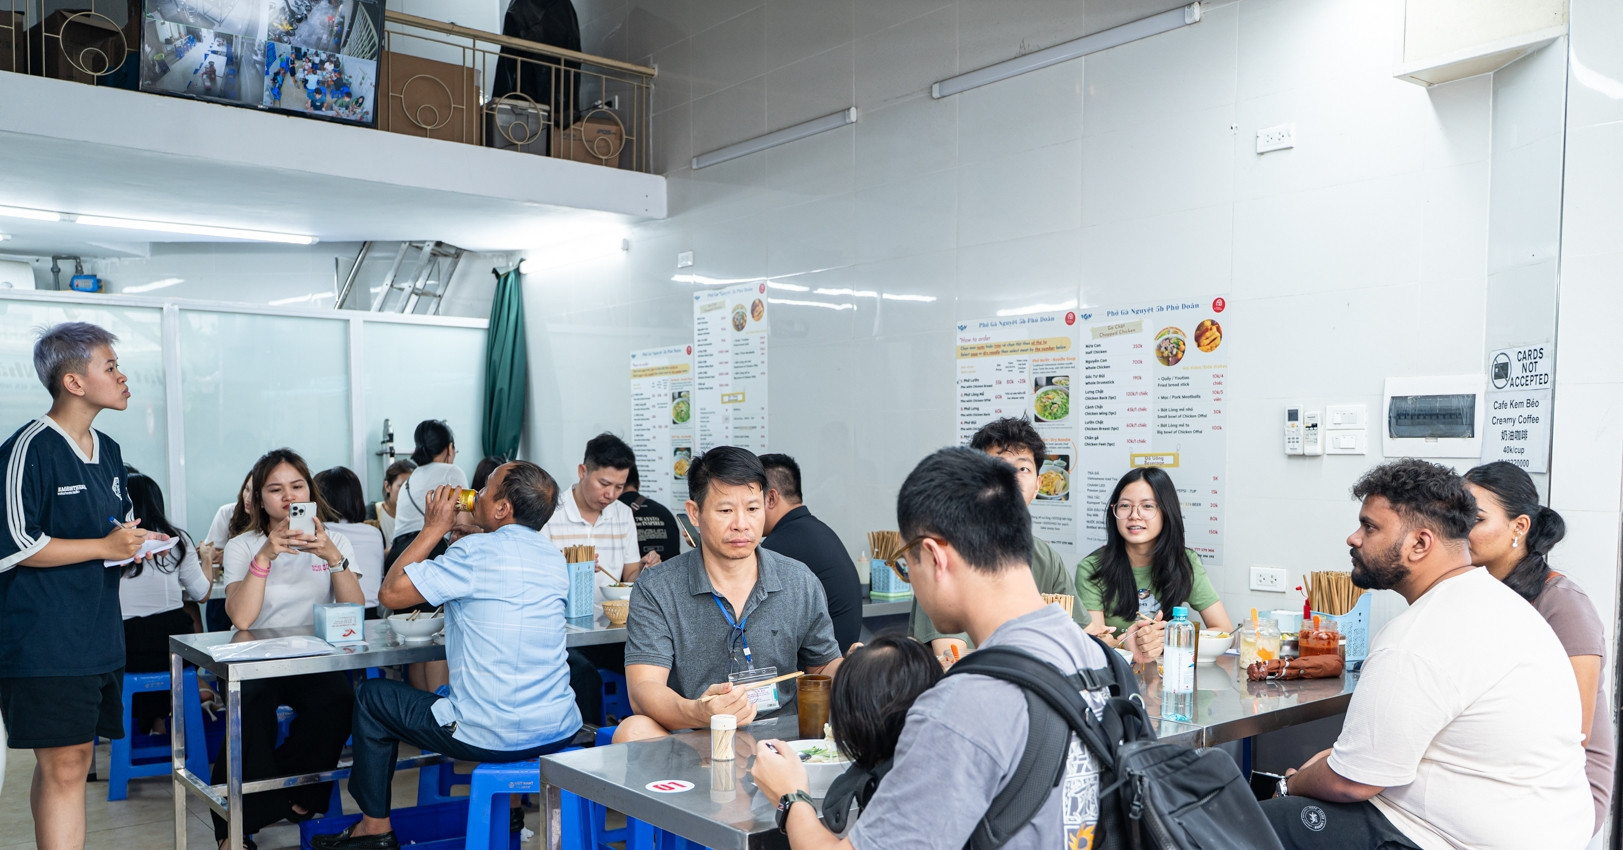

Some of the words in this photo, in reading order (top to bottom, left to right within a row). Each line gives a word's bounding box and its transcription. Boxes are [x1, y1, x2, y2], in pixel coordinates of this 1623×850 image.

[1517, 347, 1544, 362] CARDS
[1521, 361, 1538, 373] NOT
[1509, 373, 1549, 388] ACCEPTED
[1493, 400, 1508, 410] Cafe
[1509, 399, 1524, 409] Kem
[1526, 398, 1540, 408] Béo
[1491, 416, 1516, 427] Creamy
[1518, 414, 1540, 424] Coffee
[1501, 429, 1528, 441] 奶油咖啡
[1502, 445, 1525, 456] 40k/cup
